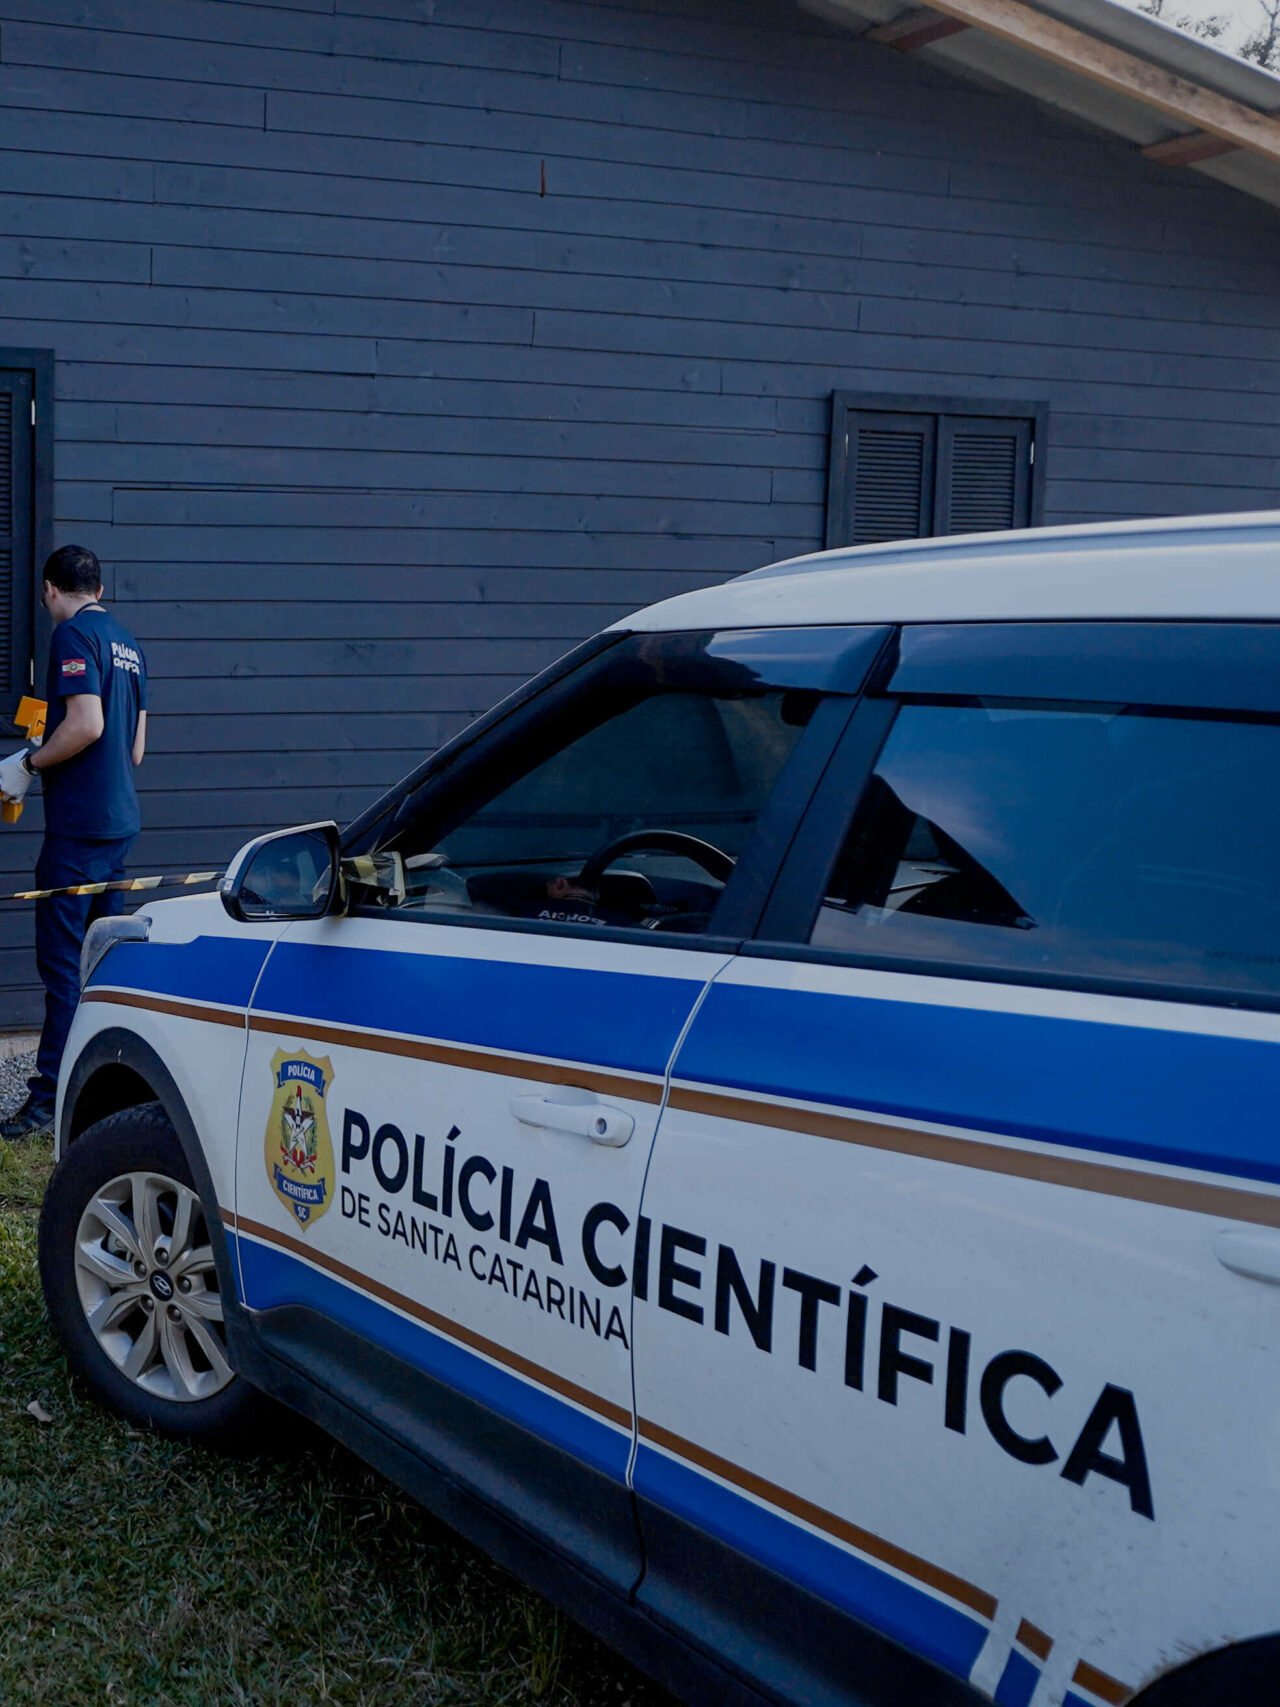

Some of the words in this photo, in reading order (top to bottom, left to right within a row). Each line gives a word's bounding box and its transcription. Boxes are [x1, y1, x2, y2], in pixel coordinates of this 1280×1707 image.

[287, 1063, 315, 1081] POLÍCIA
[282, 1179, 318, 1200] CIENTÍFICA
[297, 1206, 307, 1219] SC
[341, 1185, 370, 1228] DE
[378, 1202, 461, 1271] SANTA
[469, 1244, 630, 1350] CATARINA
[341, 1107, 564, 1266] POLÍCIA
[582, 1201, 1155, 1521] CIENTÍFICA
